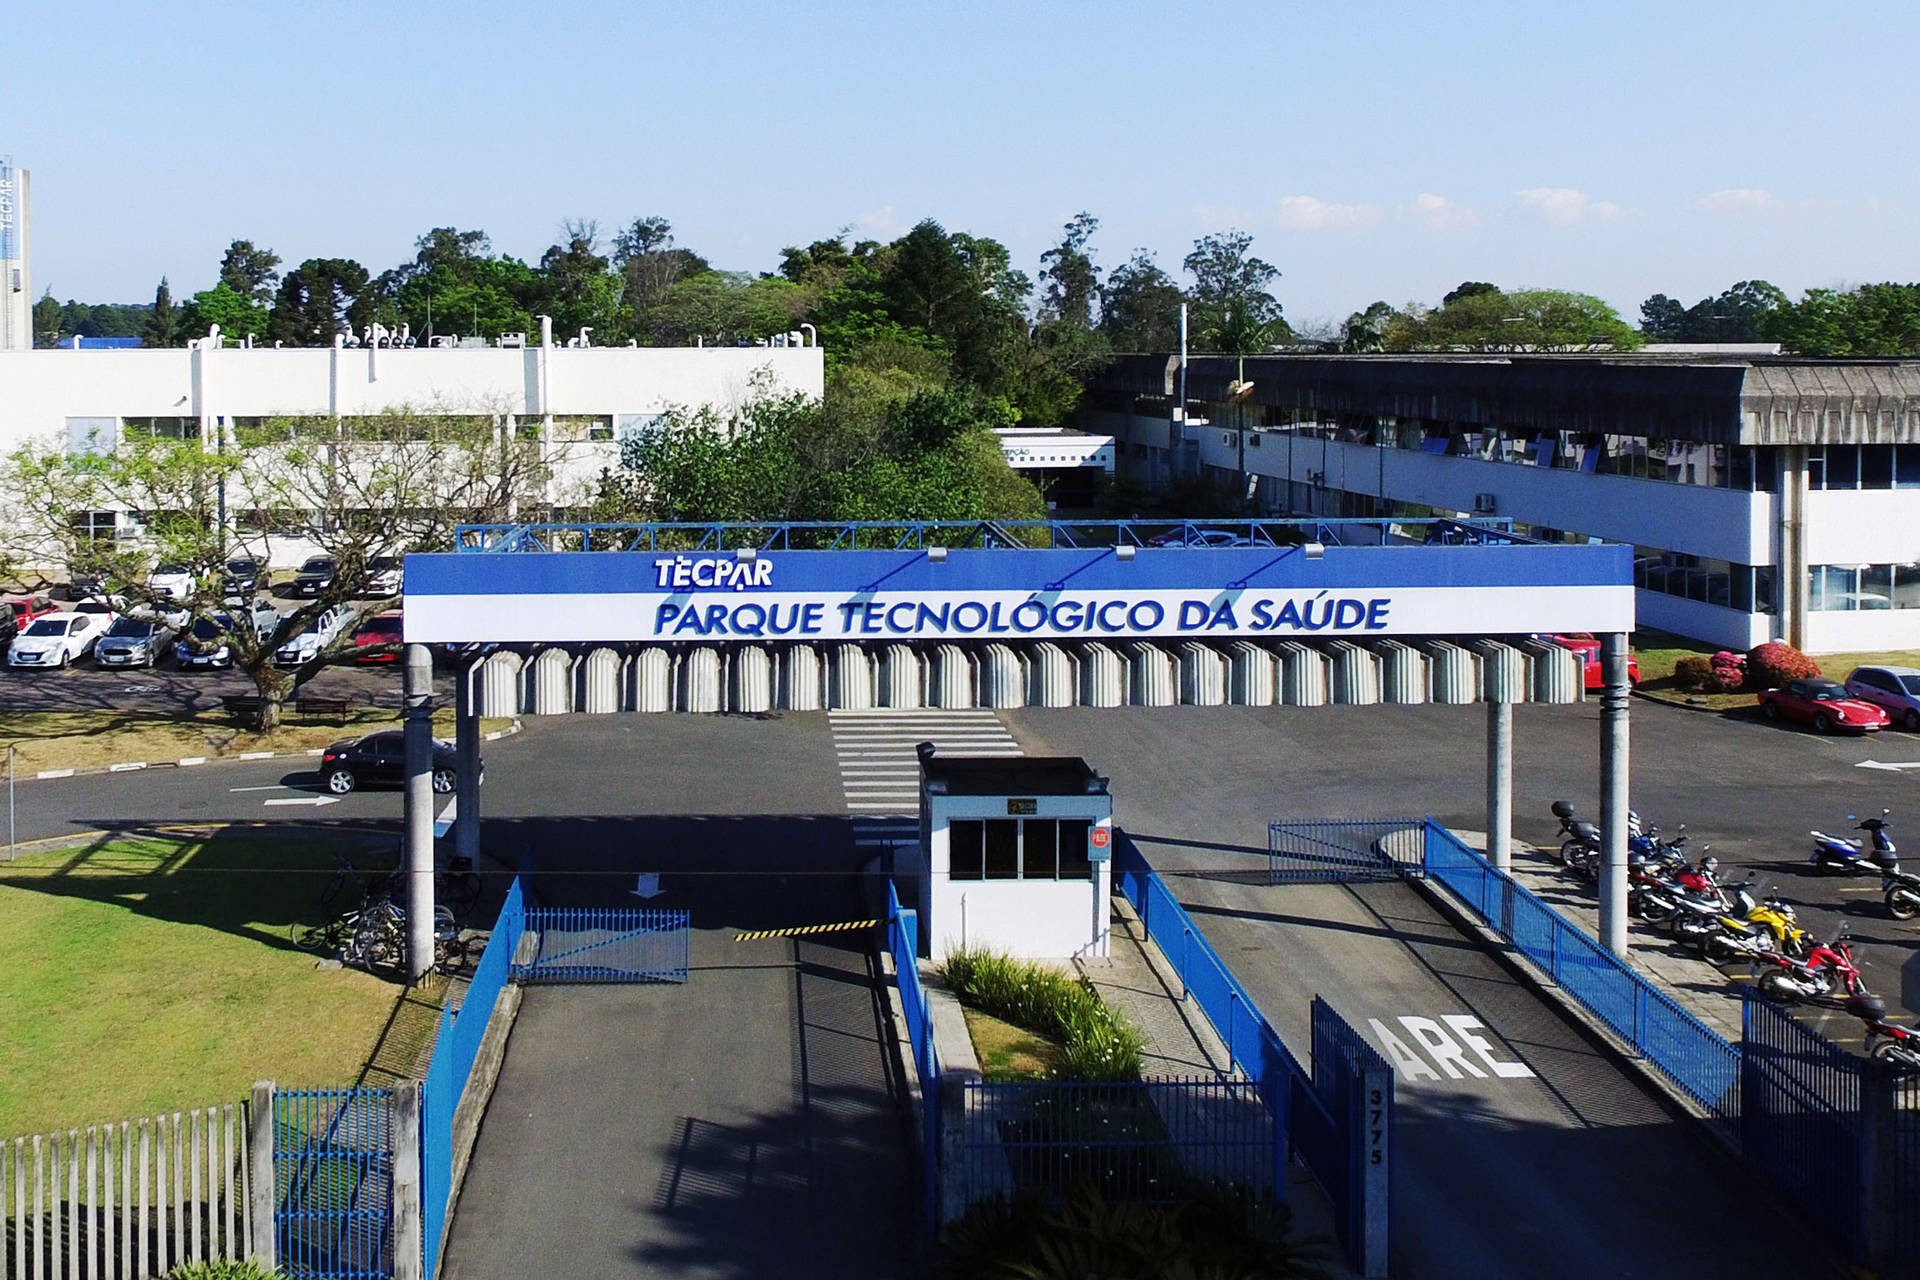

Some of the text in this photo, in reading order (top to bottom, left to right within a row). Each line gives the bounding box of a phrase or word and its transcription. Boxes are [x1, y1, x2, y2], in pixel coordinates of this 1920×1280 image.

[0, 179, 13, 231] TECPAR
[655, 556, 773, 590] TECPAR
[653, 590, 1391, 637] PARQUE TECNOLÓGICO DA SAÚDE
[1370, 1090, 1382, 1165] 3775
